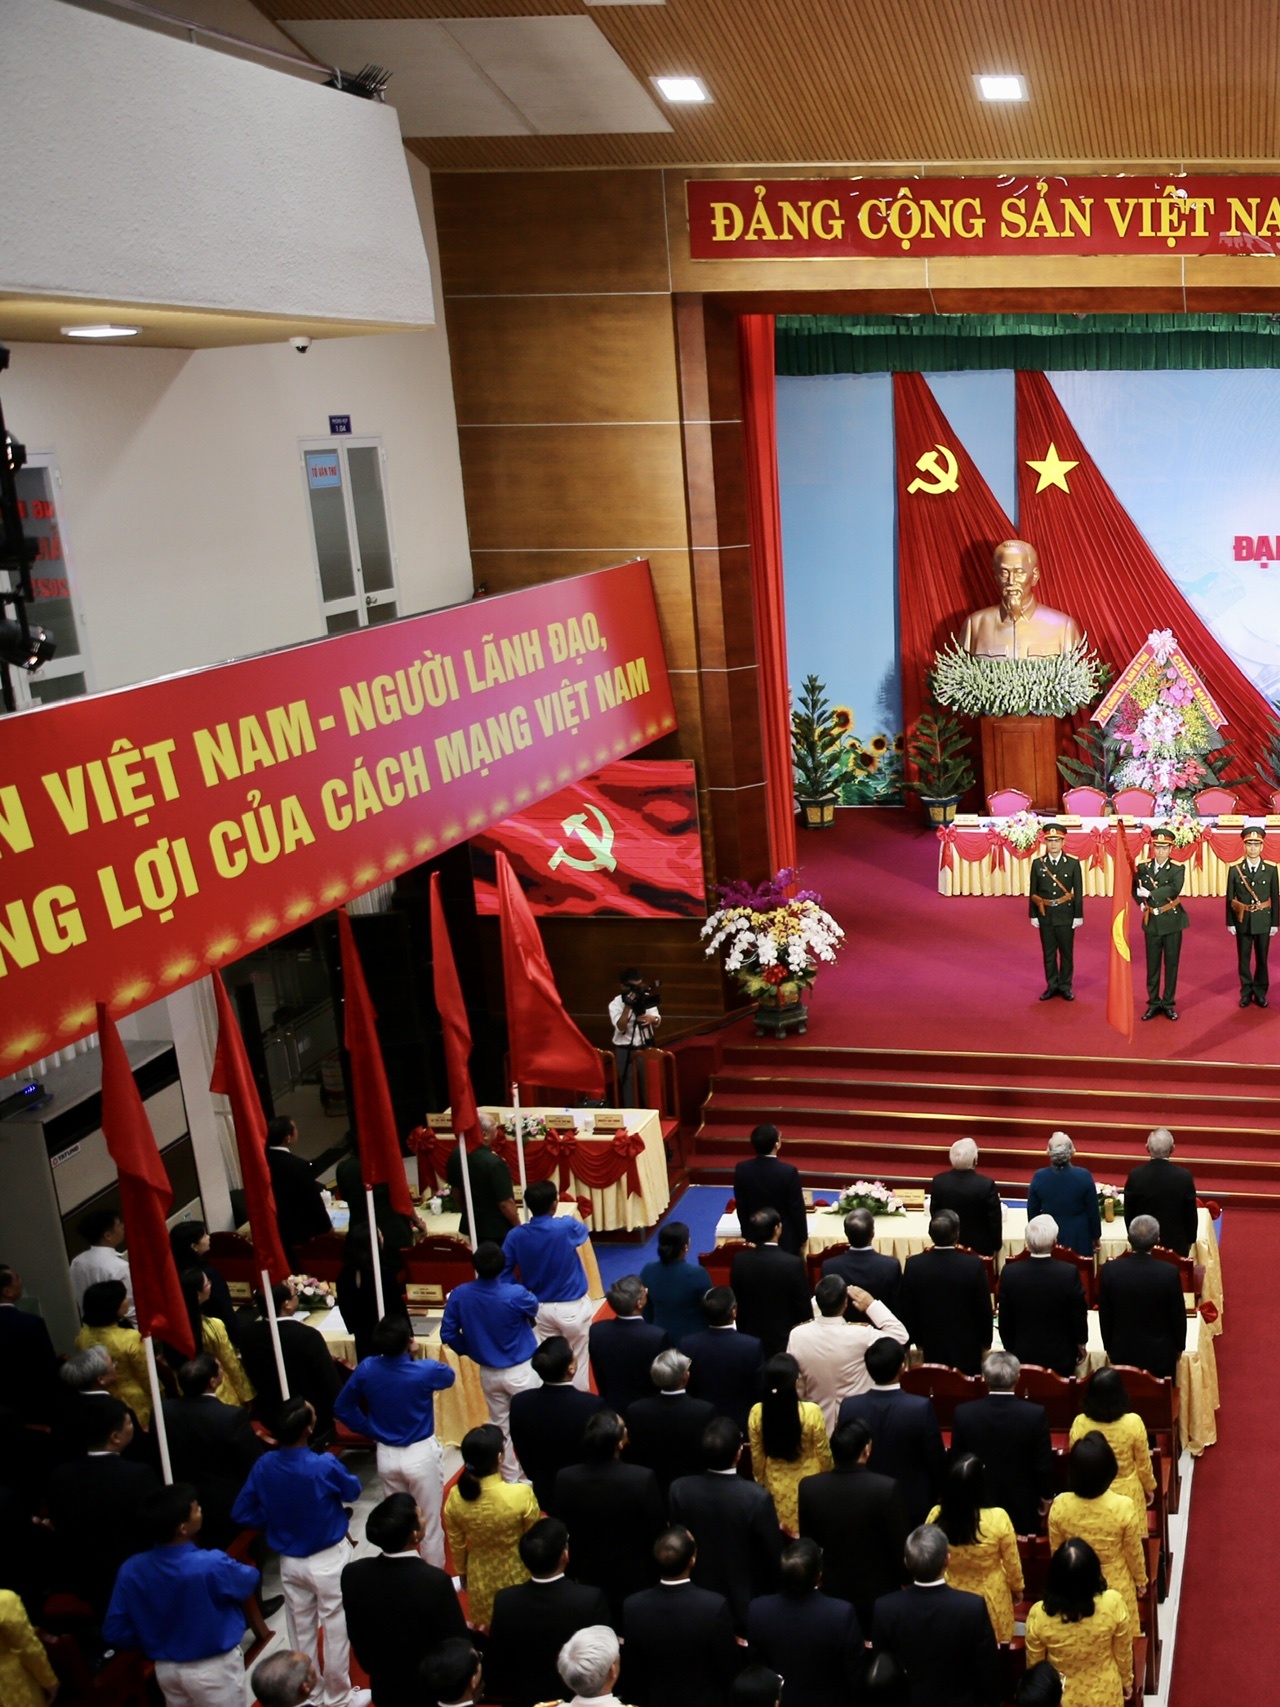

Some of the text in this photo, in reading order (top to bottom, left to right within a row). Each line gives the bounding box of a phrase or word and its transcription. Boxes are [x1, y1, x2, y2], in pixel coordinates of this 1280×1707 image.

[710, 185, 845, 241] ĐẢNG
[858, 187, 987, 251] CỘNG
[1000, 181, 1094, 239] SẢN
[1103, 184, 1215, 248] VIỆT
[0, 784, 35, 860] N
[41, 738, 181, 836] VIỆT
[192, 699, 318, 788] NAM
[339, 649, 459, 737] NGƯỜI
[464, 628, 540, 694] LÃNH
[548, 611, 609, 665] ĐẠO,
[1172, 655, 1197, 687] CHÚC
[0, 656, 651, 978] NG LỢI CỦA CÁCH MẠNG VIỆT NAM
